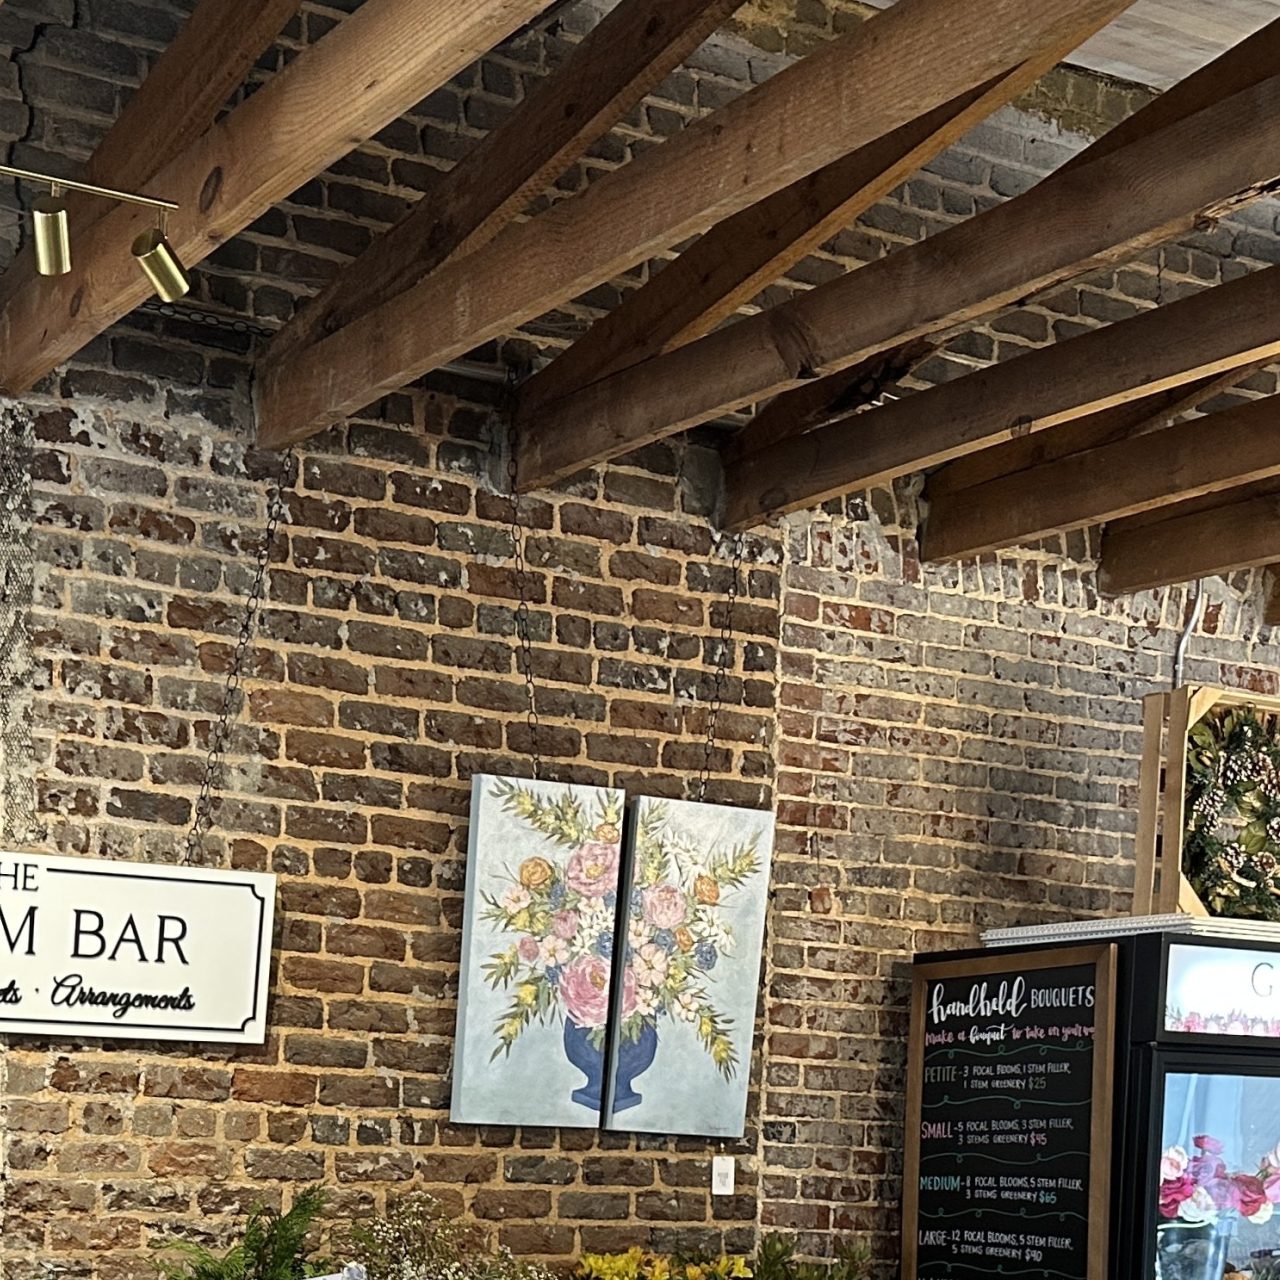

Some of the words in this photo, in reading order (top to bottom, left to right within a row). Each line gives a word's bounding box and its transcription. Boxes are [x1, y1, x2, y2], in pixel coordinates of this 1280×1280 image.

[70, 908, 189, 966] BAR
[50, 973, 195, 1019] Arrangements
[927, 976, 1028, 1025] handheld
[1031, 985, 1095, 1009] BOUQUETS
[968, 1023, 1014, 1046] bouquet
[1025, 1025, 1046, 1040] take
[972, 1065, 995, 1076] FOCAL
[1027, 1063, 1046, 1074] STEM
[970, 1079, 989, 1089] STEM
[991, 1078, 1027, 1090] GREENERY
[1028, 1076, 1047, 1091] $25
[966, 1120, 989, 1132] FOCAL
[1028, 1118, 1047, 1130] STEM
[966, 1133, 990, 1144] STEMS
[992, 1133, 1029, 1145] GREENERY
[1029, 1130, 1047, 1147] $45
[974, 1176, 997, 1187] FOCAL
[1037, 1177, 1056, 1188] STEM
[974, 1189, 998, 1199] STEMS
[1000, 1190, 1037, 1203] GREENERY
[1038, 1190, 1057, 1204] $65
[964, 1230, 985, 1243] FOCAL
[1026, 1235, 1046, 1247] STEM
[960, 1243, 983, 1255] STEMS
[985, 1246, 1022, 1260] GREENERY
[1024, 1247, 1043, 1262] $90
